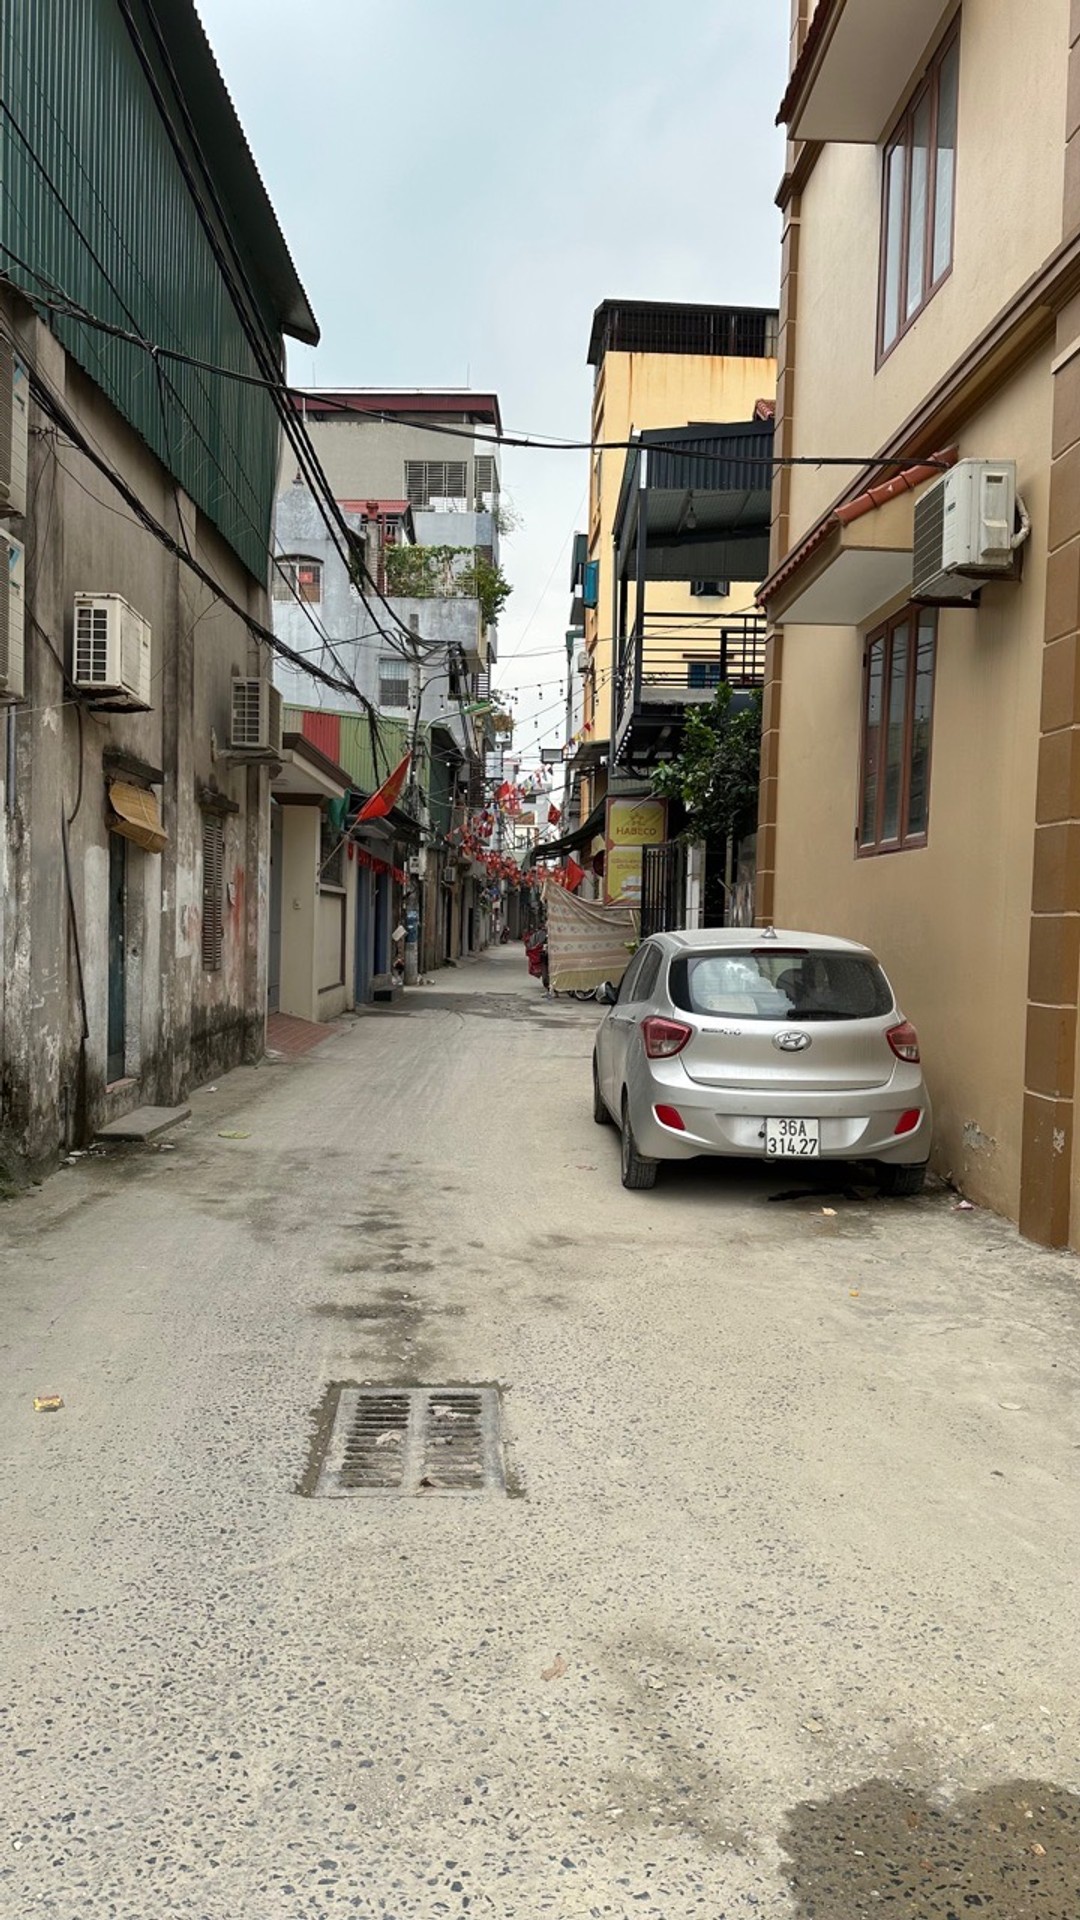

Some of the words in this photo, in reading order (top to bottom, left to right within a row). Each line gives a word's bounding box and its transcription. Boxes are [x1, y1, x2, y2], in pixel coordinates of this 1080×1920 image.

[616, 826, 657, 836] HABECO
[779, 1119, 807, 1136] 36A
[768, 1137, 818, 1155] 314.27
